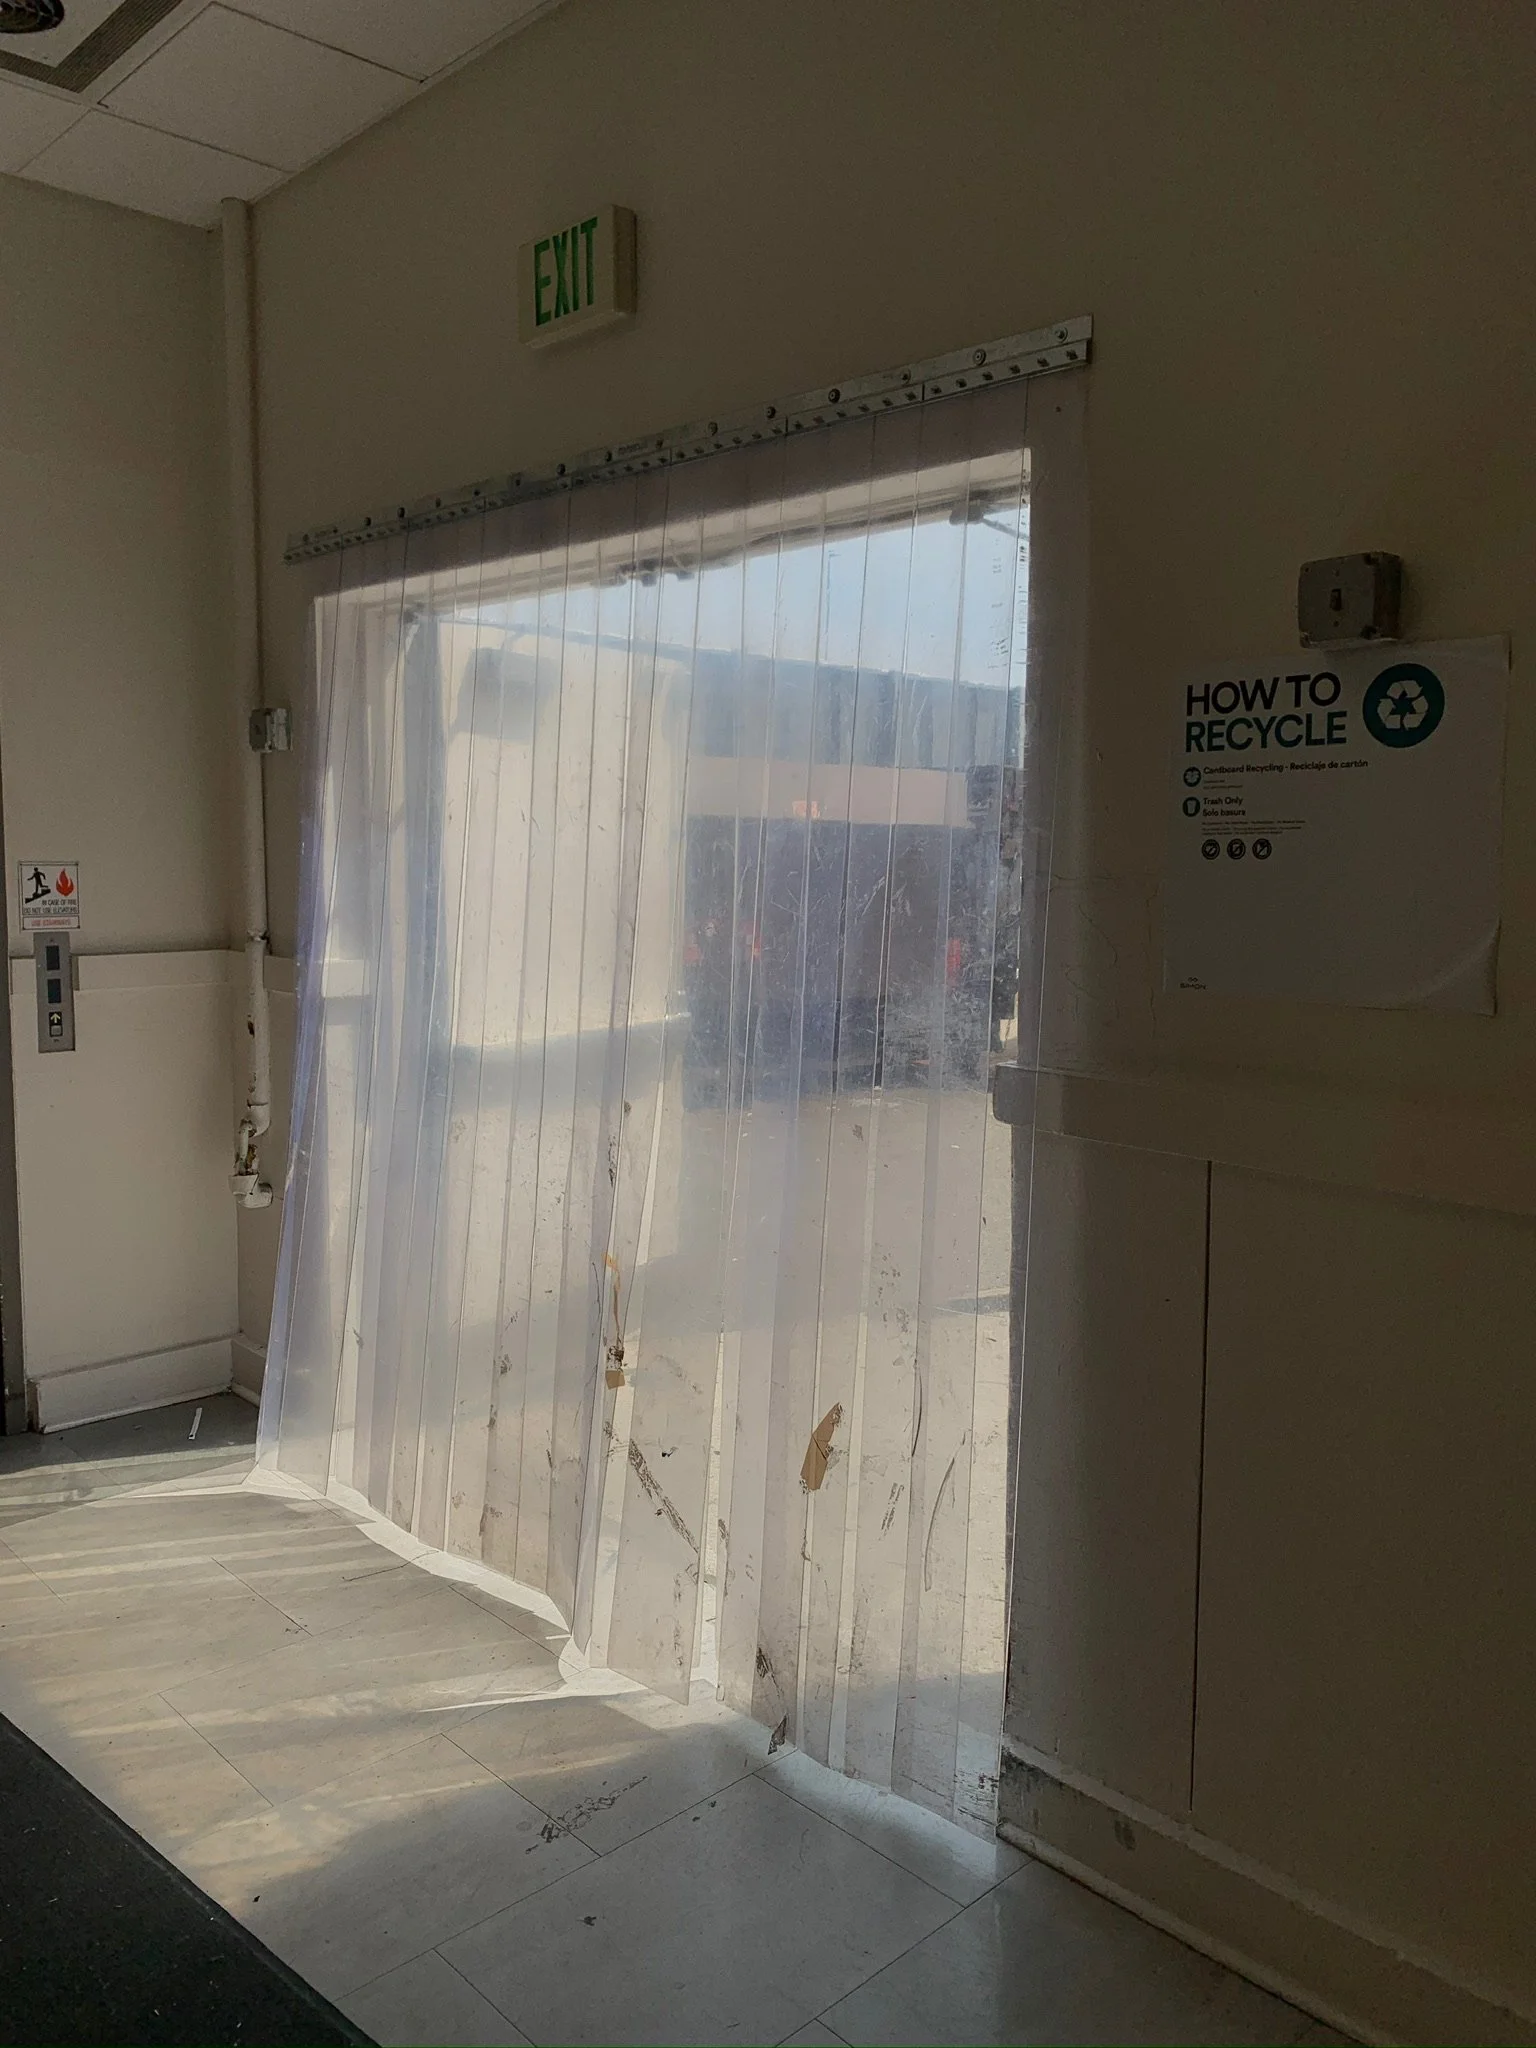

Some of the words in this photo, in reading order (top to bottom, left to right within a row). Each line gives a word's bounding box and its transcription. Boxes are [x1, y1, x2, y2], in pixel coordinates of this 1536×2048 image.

[534, 216, 598, 326] EXIT
[1187, 677, 1280, 716] HOW
[1285, 672, 1341, 708] TO
[1186, 711, 1347, 752] RECYCLE
[1246, 763, 1284, 774] Recycling
[1290, 761, 1326, 771] Reciclaje
[1328, 761, 1338, 769] de
[1340, 759, 1368, 768] cartón
[1203, 797, 1223, 805] Trash
[1224, 796, 1243, 806] Only
[1203, 808, 1219, 817] Solo
[1220, 808, 1246, 817] basura
